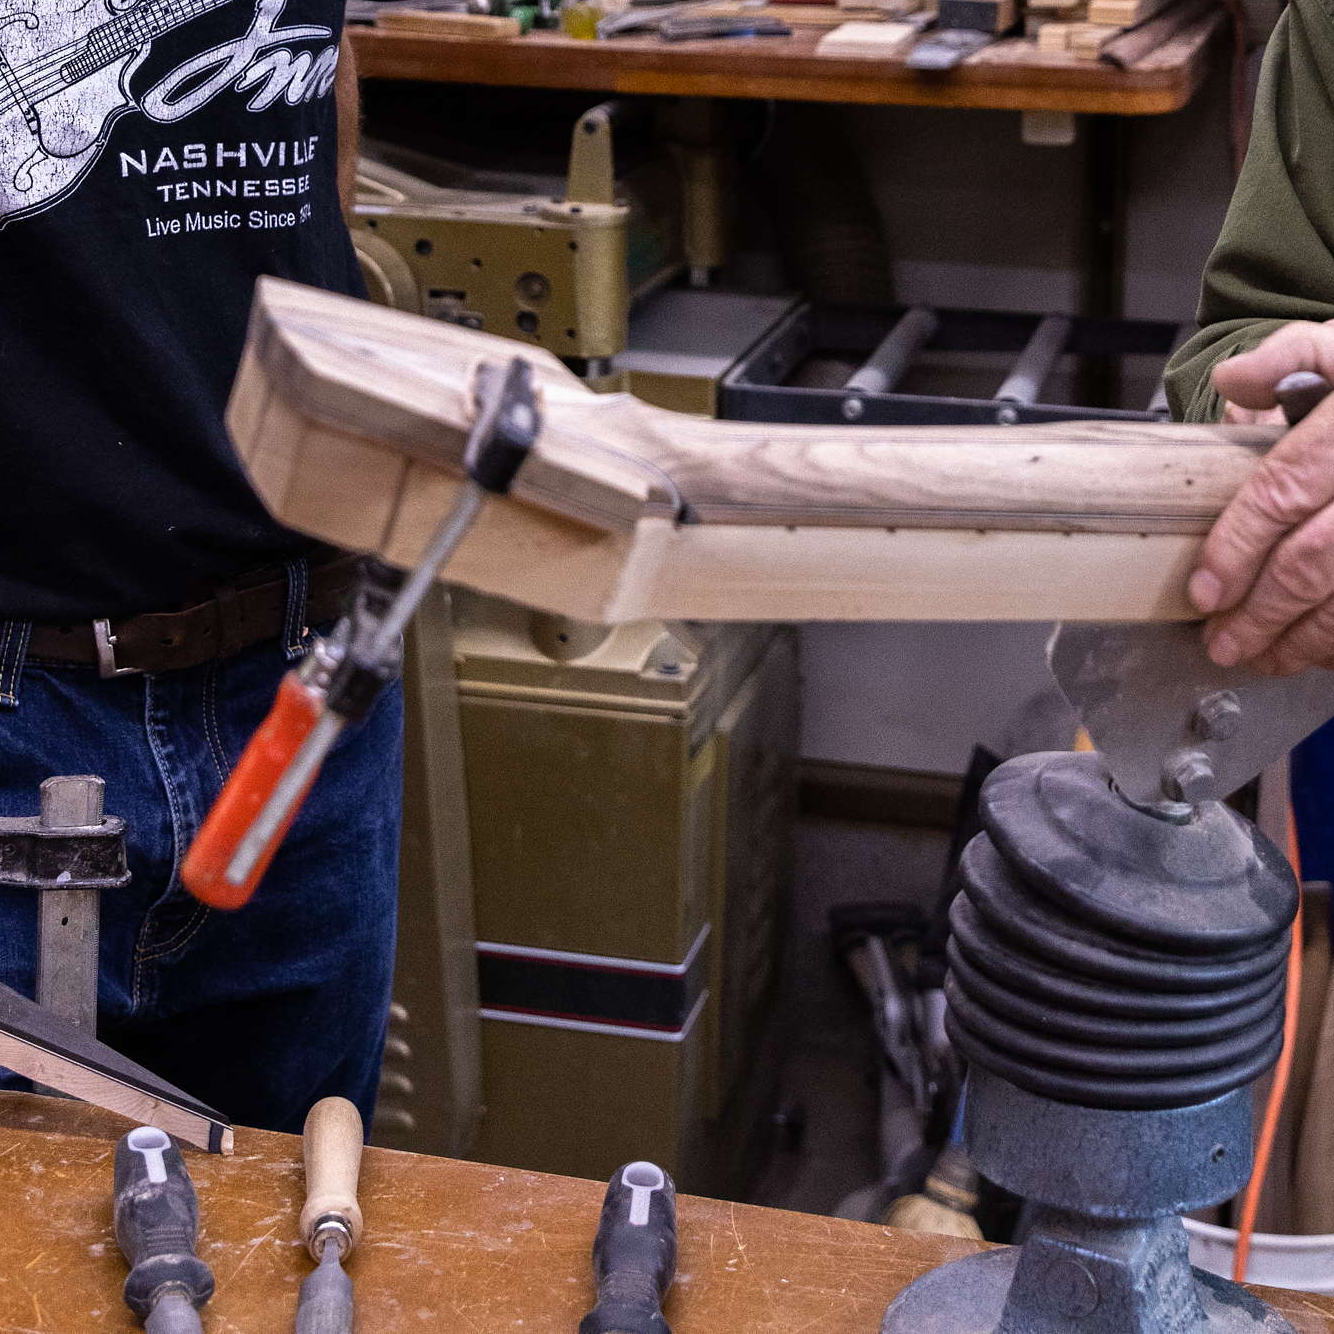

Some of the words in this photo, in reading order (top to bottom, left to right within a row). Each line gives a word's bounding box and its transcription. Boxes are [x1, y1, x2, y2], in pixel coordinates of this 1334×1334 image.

[119, 135, 319, 178] NASHVILLE
[156, 174, 310, 203] TENNESSEE
[146, 216, 181, 238] Live
[185, 209, 242, 233] Music
[247, 209, 296, 229] Since
